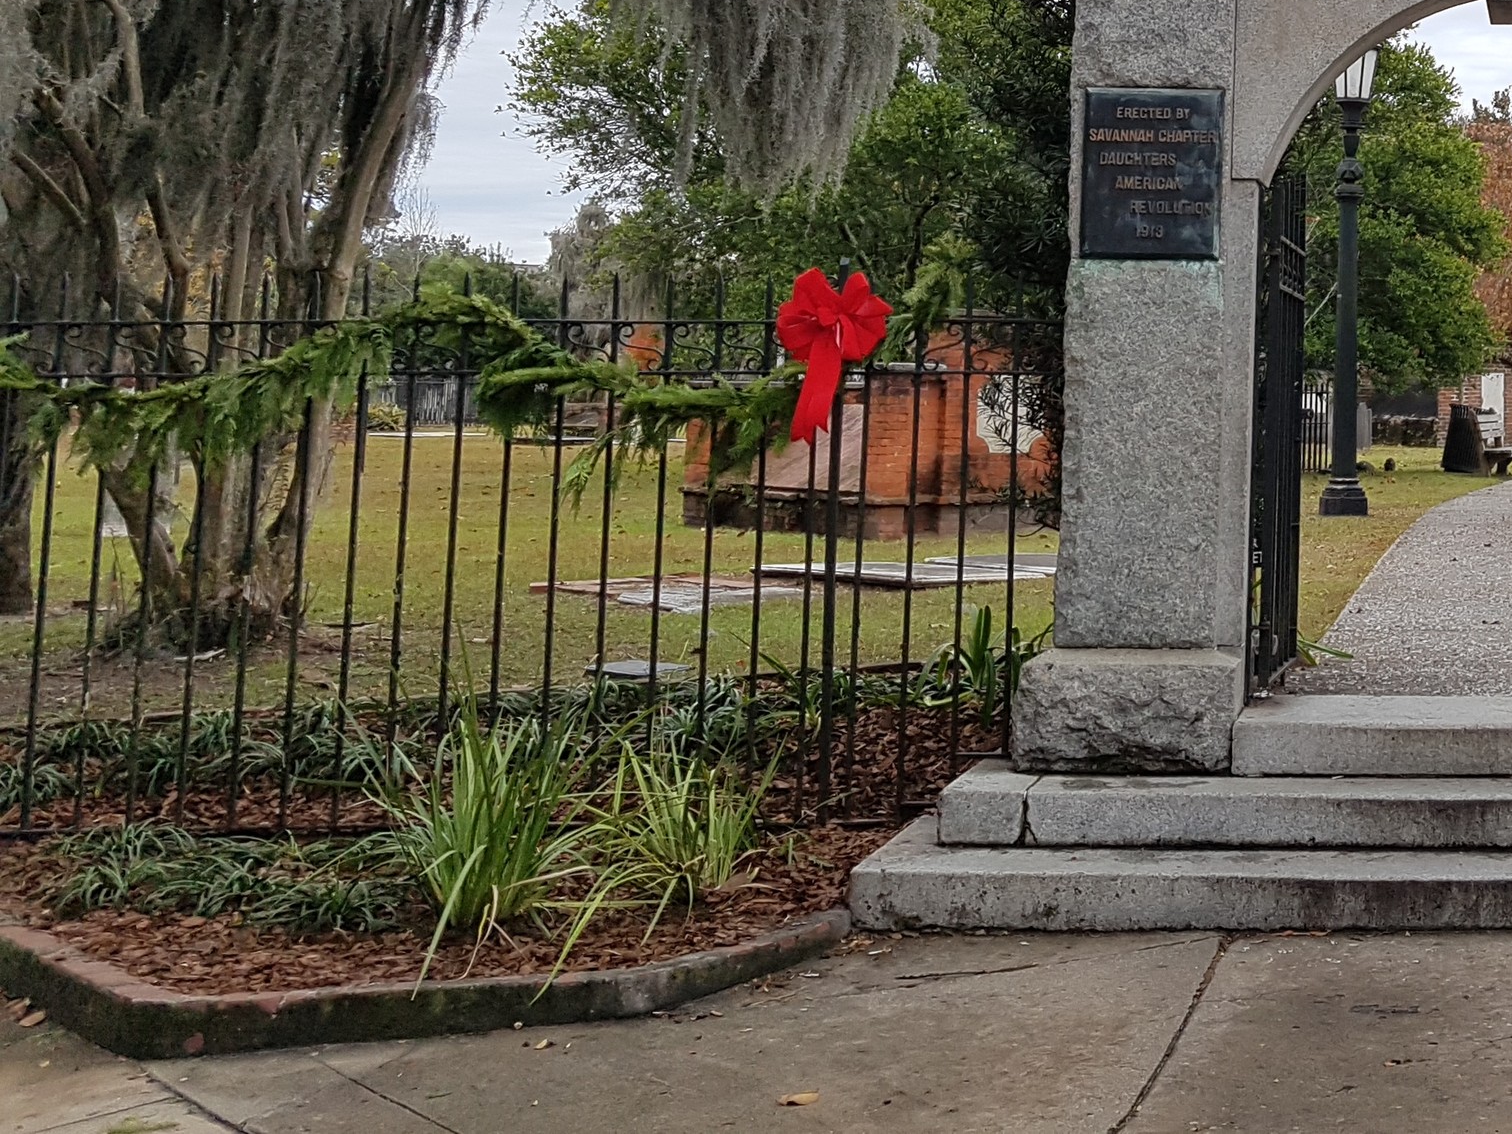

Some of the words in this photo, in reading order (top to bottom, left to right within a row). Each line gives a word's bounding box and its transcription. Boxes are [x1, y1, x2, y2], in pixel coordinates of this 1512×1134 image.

[1116, 106, 1171, 119] ERECTED
[1176, 107, 1190, 119] BY
[1089, 128, 1154, 143] SAVANNAH
[1158, 129, 1217, 144] CHAPTER
[1099, 152, 1177, 167] DAUGHTERS
[1114, 175, 1183, 191] AMERICAN
[1130, 200, 1213, 215] REVOLUTION
[1135, 224, 1164, 239] 1913
